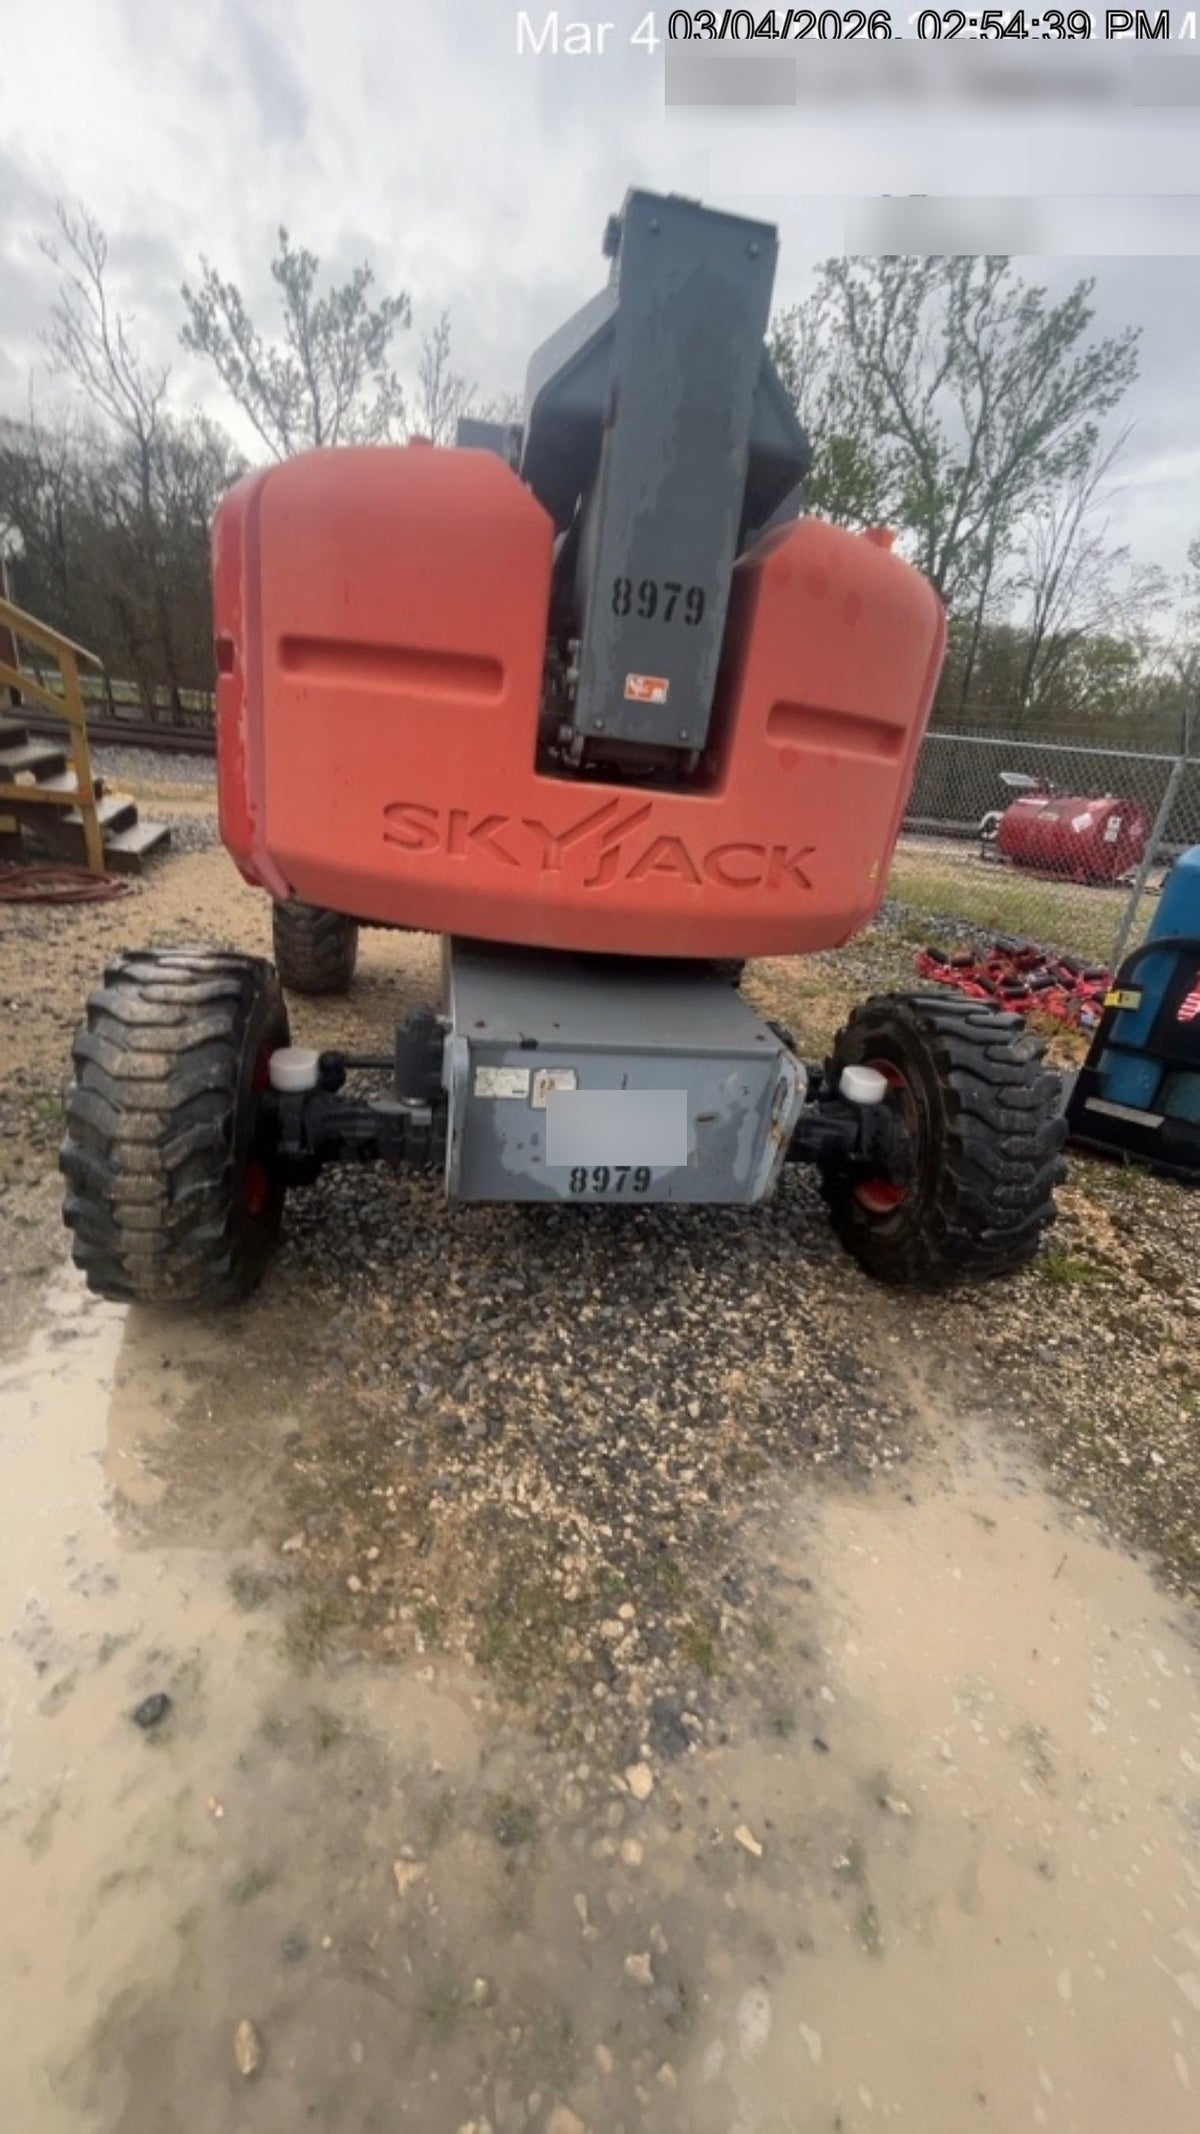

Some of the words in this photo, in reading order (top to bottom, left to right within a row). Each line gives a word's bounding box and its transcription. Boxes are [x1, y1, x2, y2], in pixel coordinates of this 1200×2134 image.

[611, 577, 706, 626] 8979
[383, 797, 816, 889] SKYJACK
[568, 1165, 652, 1195] 8979
